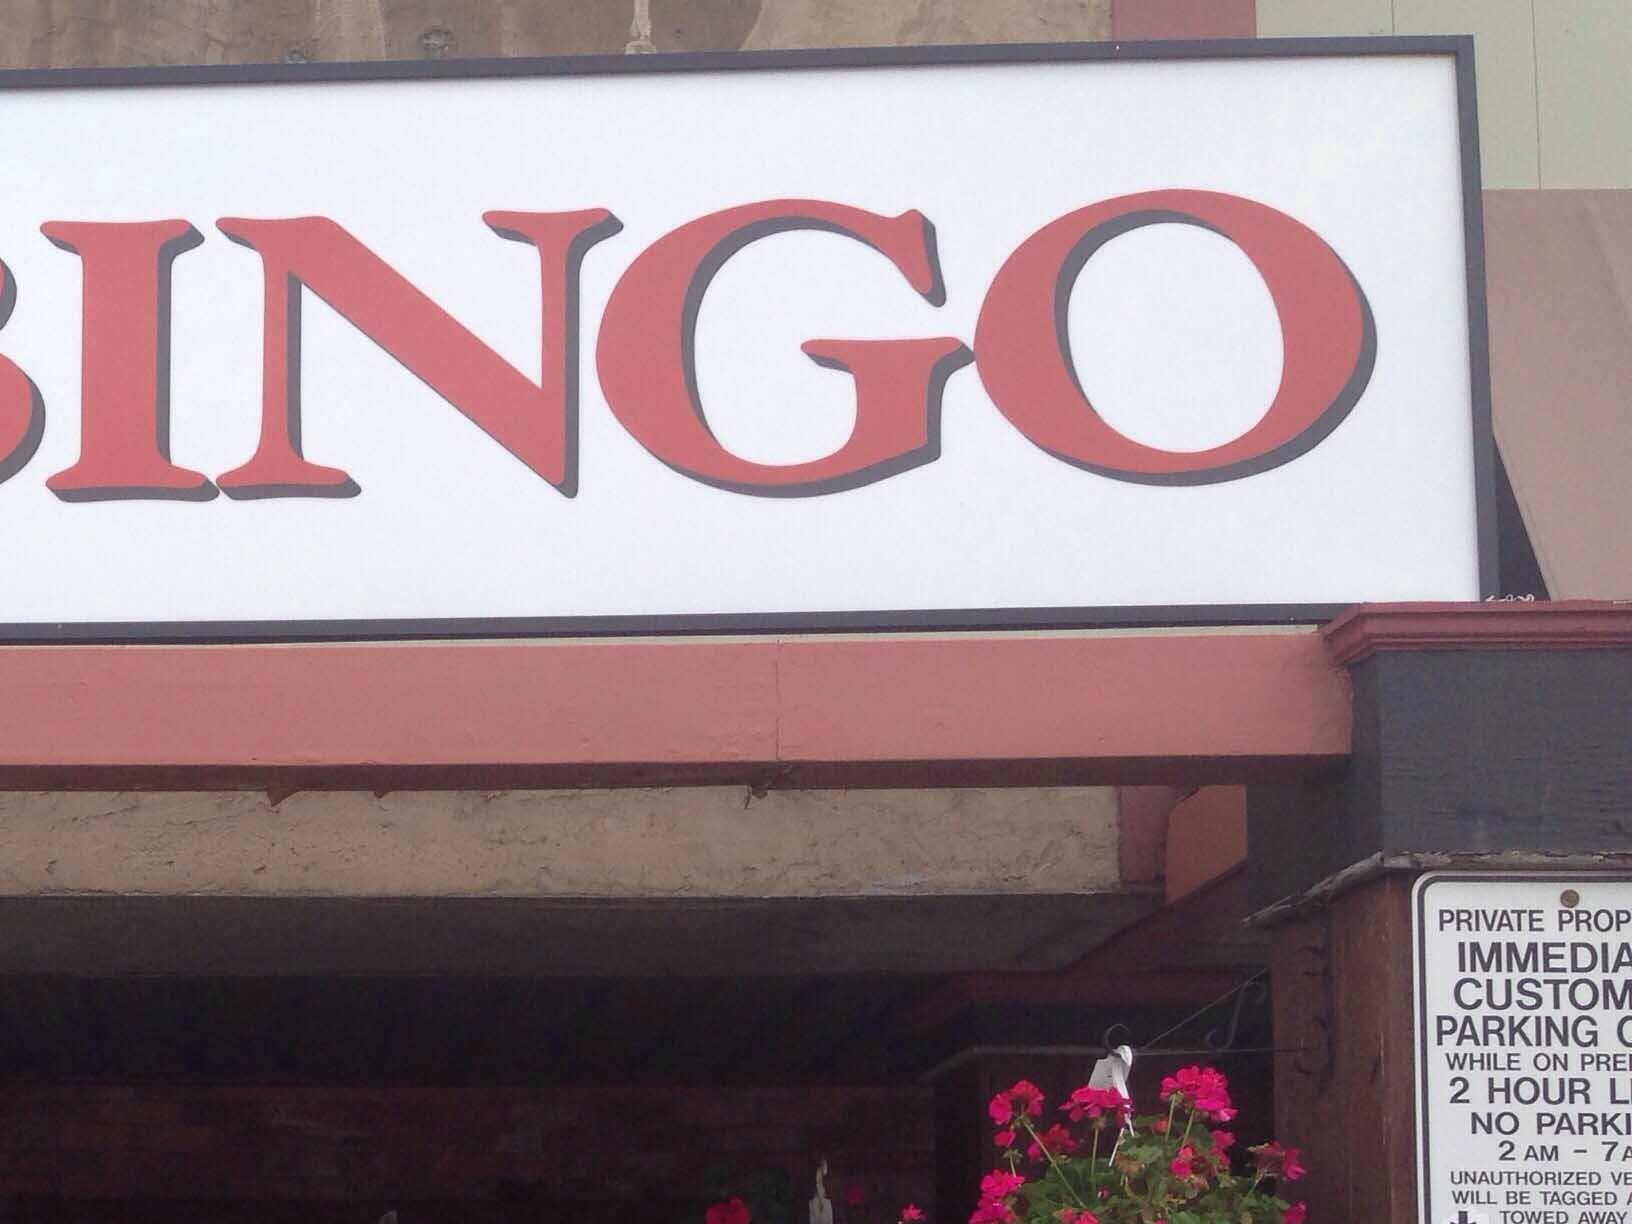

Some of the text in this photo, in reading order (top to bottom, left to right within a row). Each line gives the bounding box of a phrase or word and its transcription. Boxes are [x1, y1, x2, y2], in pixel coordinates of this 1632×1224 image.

[1439, 909, 1632, 932] PRIVATE PROP
[1458, 942, 1632, 973] IMMEDIA
[1453, 977, 1632, 1011] CUSTOM
[1436, 1015, 1599, 1048] PARKING
[1445, 1052, 1632, 1072] WHILE ON PRE
[1449, 1076, 1632, 1105] 2 HOUR L
[1471, 1111, 1632, 1136] NO PARKI
[1450, 1171, 1602, 1186] UNAUTHORIZED
[1451, 1190, 1497, 1205] WILL
[1506, 1191, 1531, 1205] BE
[1539, 1191, 1618, 1206] TAGGED
